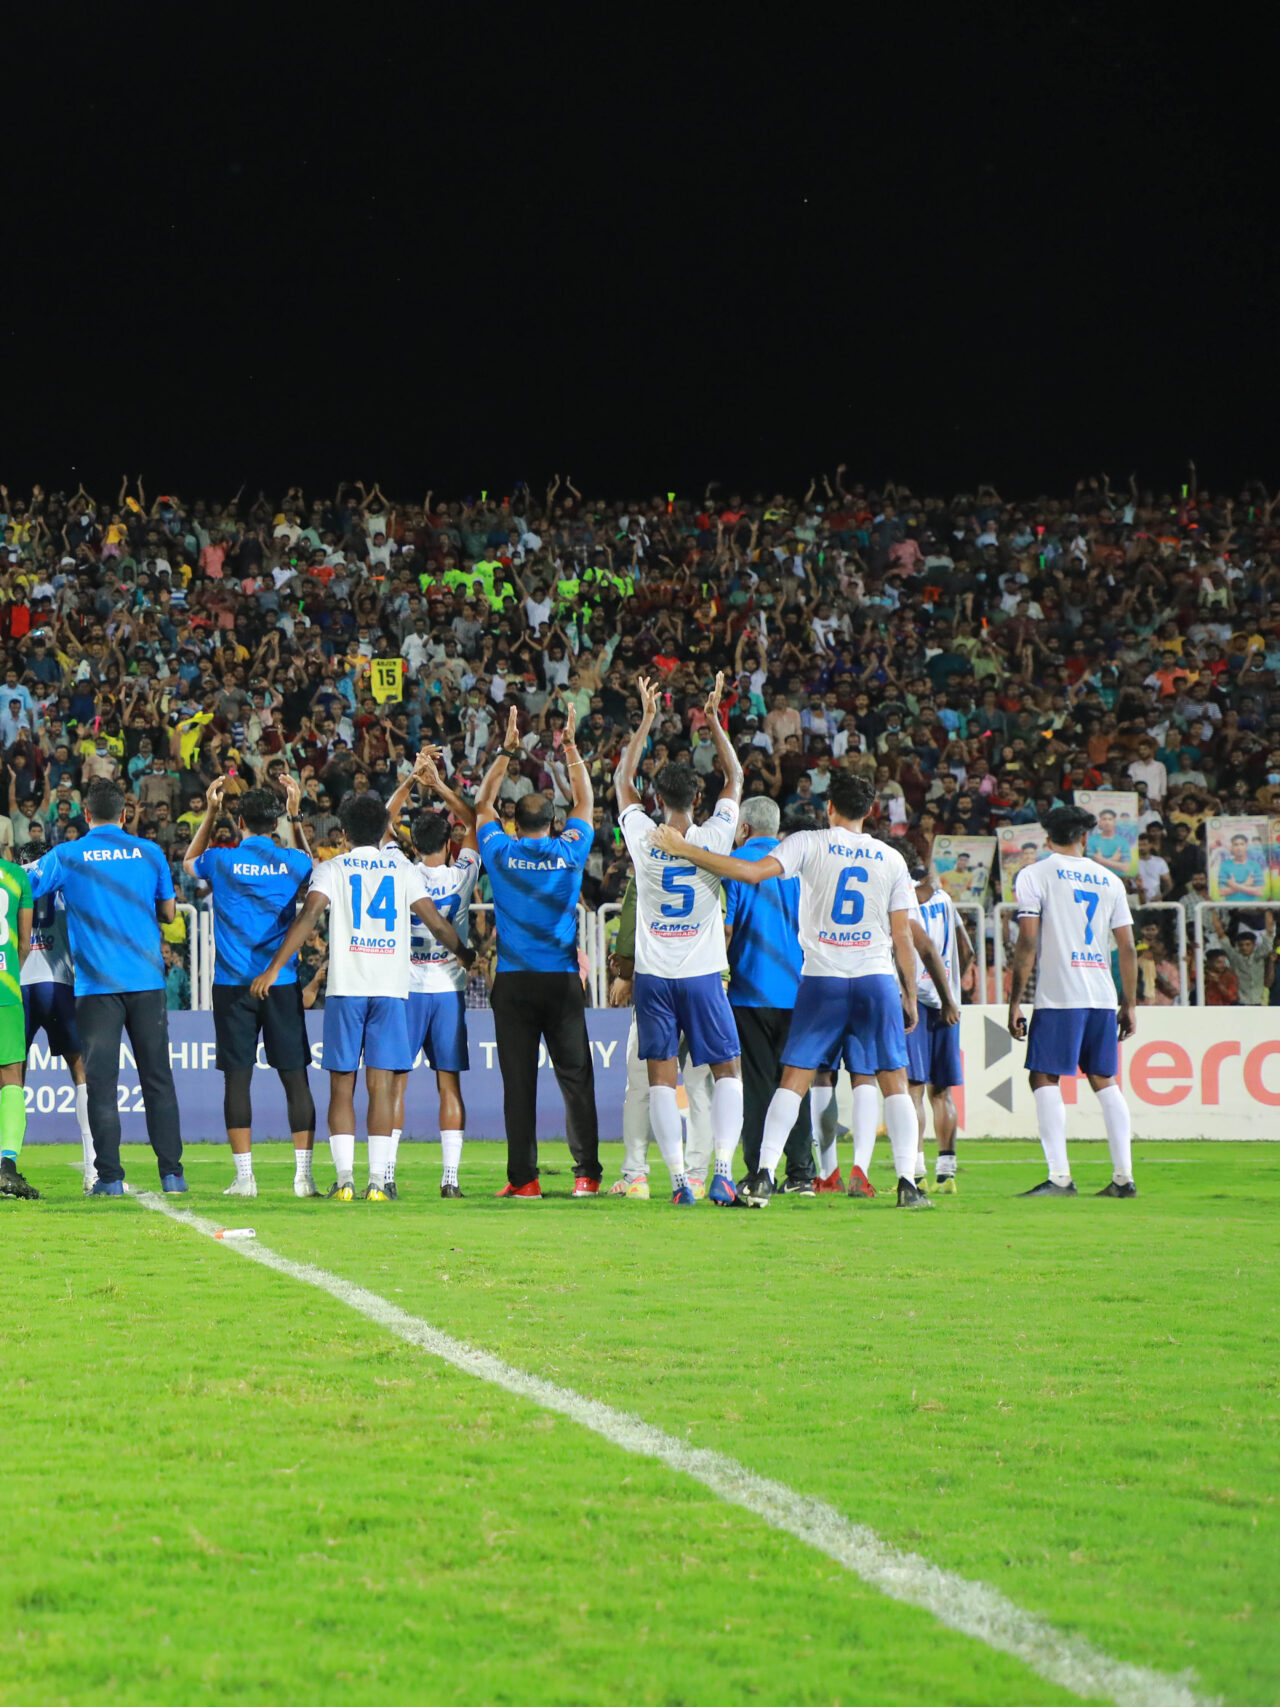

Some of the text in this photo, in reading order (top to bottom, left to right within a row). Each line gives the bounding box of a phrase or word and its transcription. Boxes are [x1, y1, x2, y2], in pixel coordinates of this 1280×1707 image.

[379, 669, 396, 686] 15
[83, 848, 142, 861] KERALA
[829, 844, 883, 861] KERALA
[233, 864, 288, 875] KERALA
[344, 858, 397, 870] KERALA
[508, 857, 566, 870] KERALA
[1057, 869, 1110, 887] KERALA
[660, 866, 697, 917] 5
[831, 866, 869, 925] 6
[349, 874, 397, 932] 14
[1073, 889, 1099, 945] 7
[351, 936, 396, 948] RAMCO
[819, 931, 872, 941] RAMCO
[410, 951, 448, 960] AMCO
